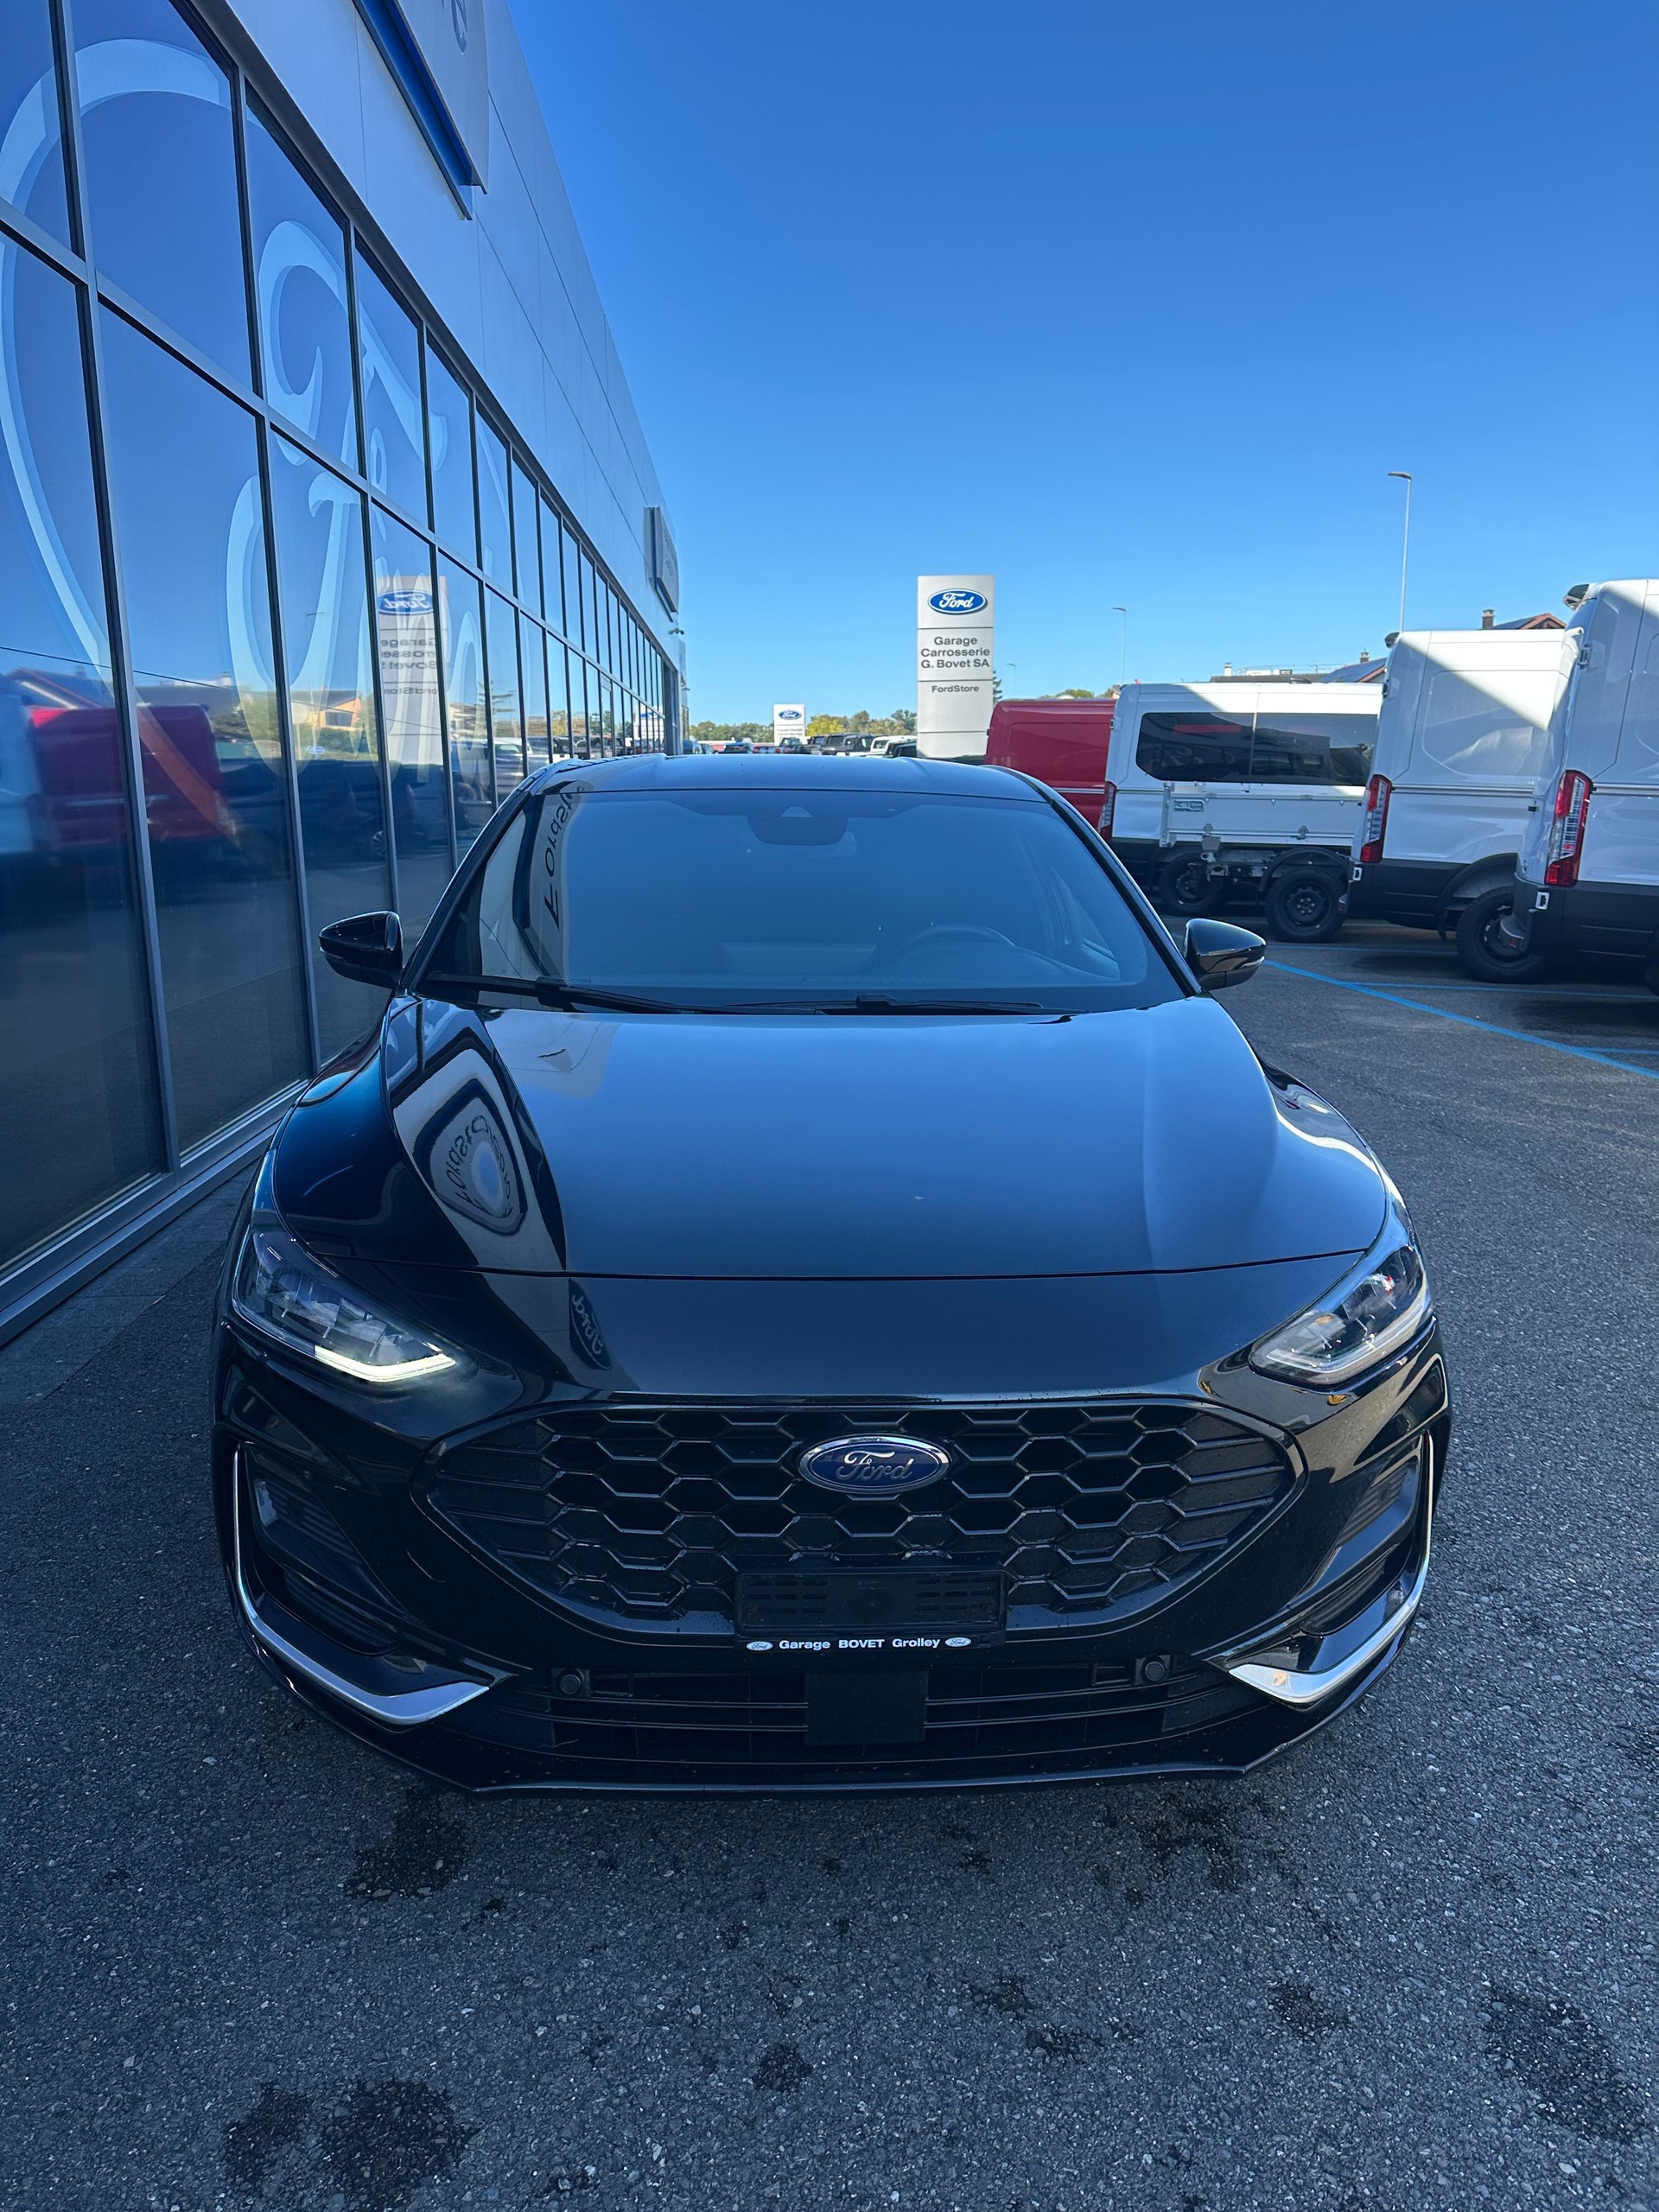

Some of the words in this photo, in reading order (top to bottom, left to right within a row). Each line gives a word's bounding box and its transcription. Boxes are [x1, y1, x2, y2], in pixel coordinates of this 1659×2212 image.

[939, 592, 975, 609] Ford
[934, 636, 978, 647] Garage
[920, 647, 991, 658] Carrosserie
[920, 659, 934, 669] G.
[937, 658, 971, 668] Bovet
[973, 658, 990, 668] SA
[931, 684, 980, 693] FordStore
[836, 1450, 916, 1482] Ford
[779, 1640, 830, 1651] Garage
[838, 1639, 885, 1649] BOVET
[892, 1637, 940, 1649] Grolley
